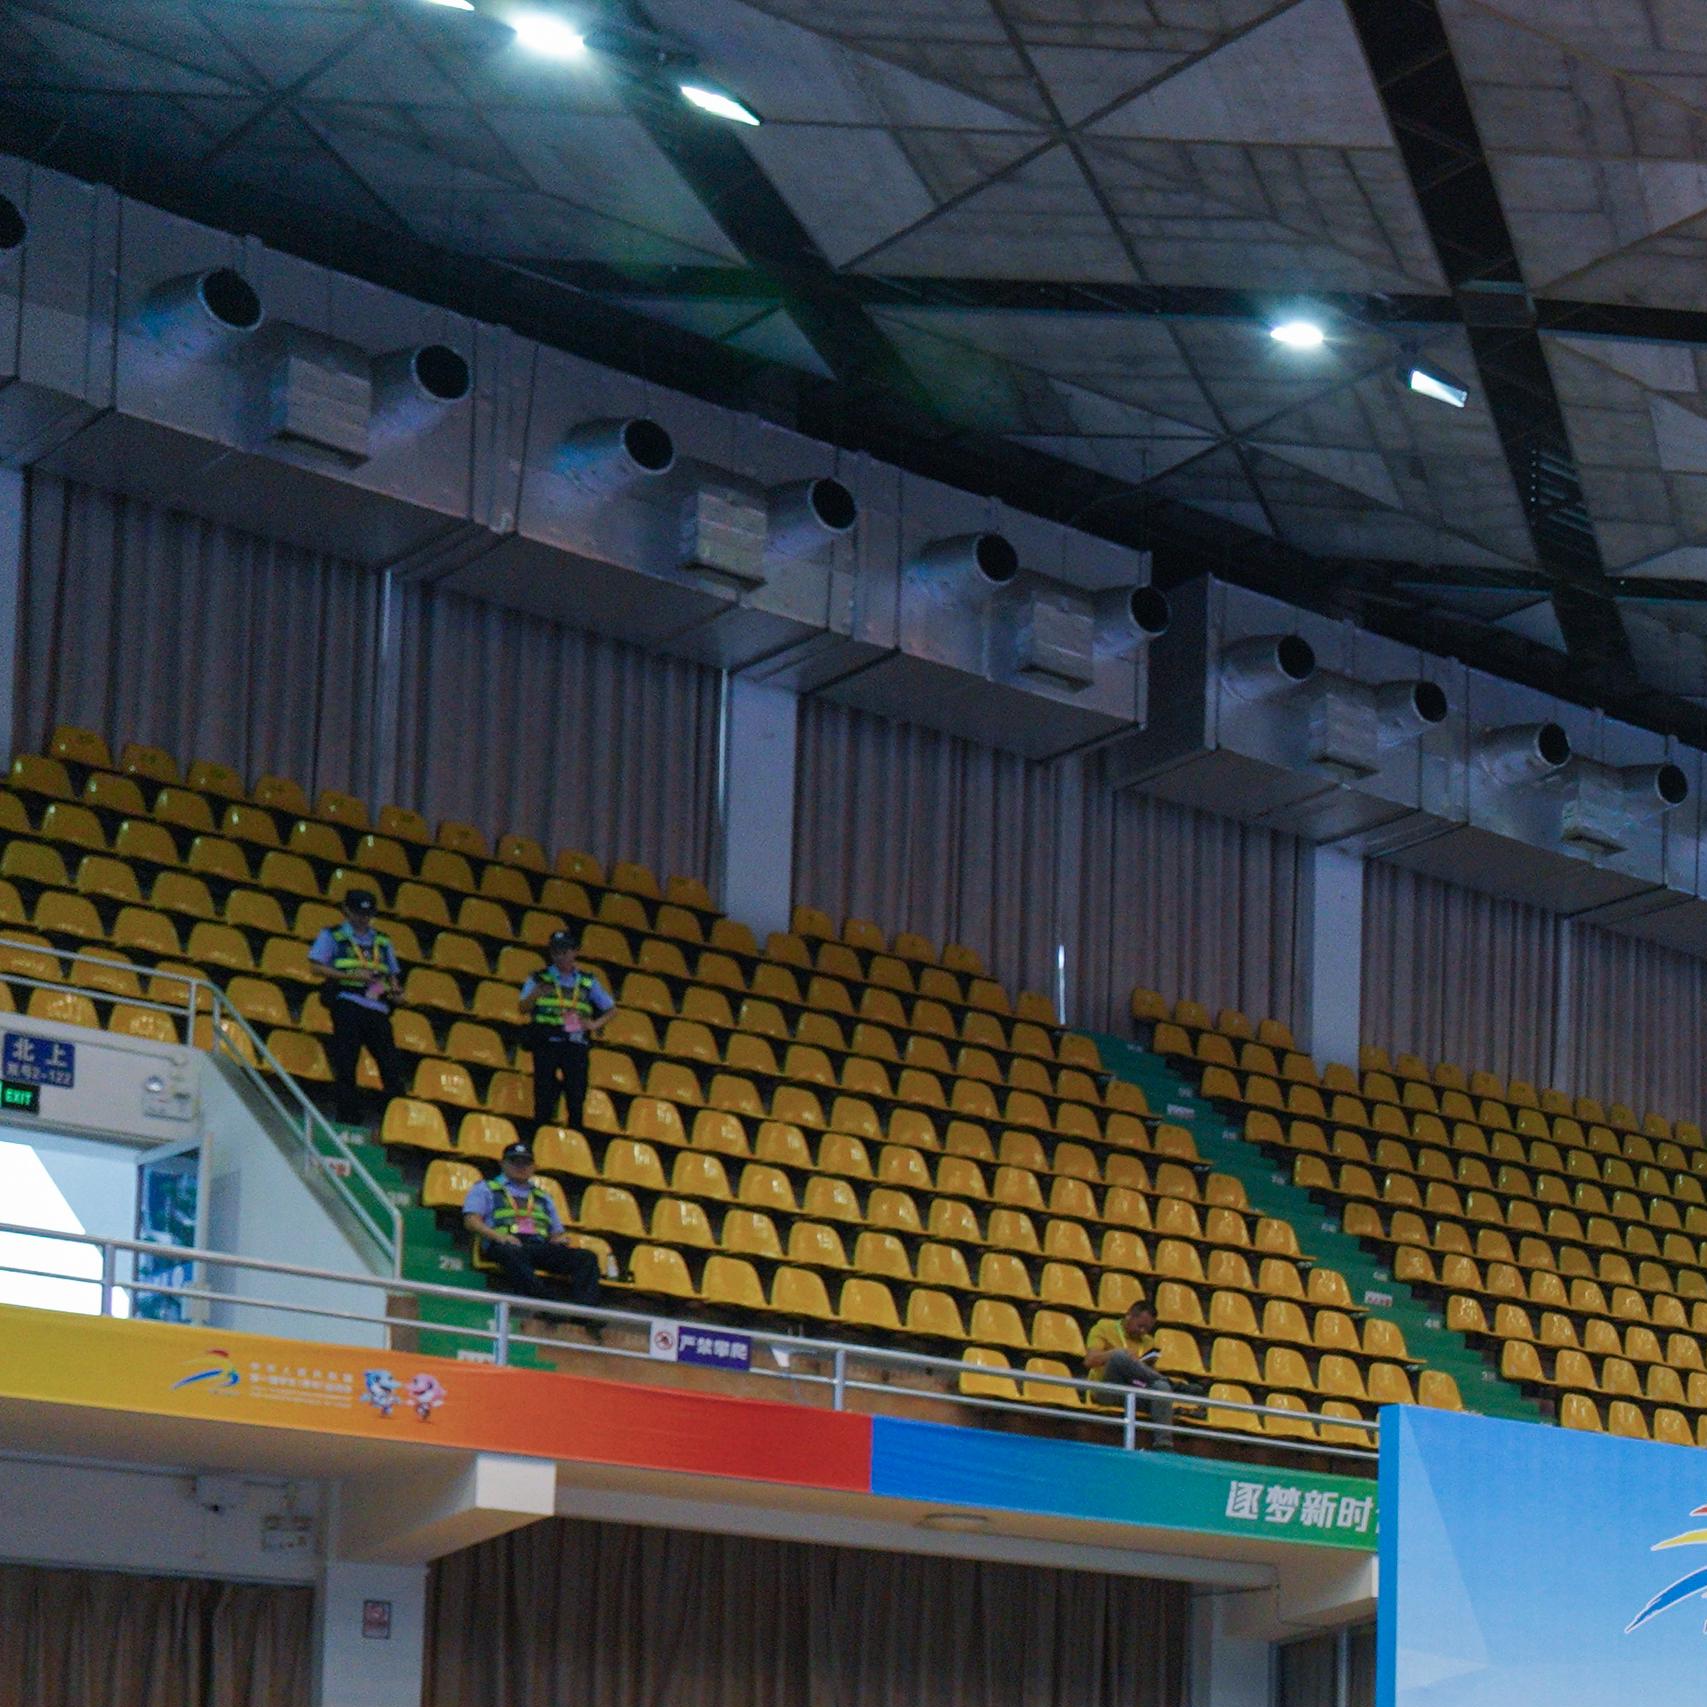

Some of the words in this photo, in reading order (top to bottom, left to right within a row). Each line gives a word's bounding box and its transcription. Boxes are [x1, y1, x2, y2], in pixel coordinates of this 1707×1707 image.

[5, 1087, 33, 1105] EXIT
[1226, 1479, 1379, 1533] 逐梦新时
